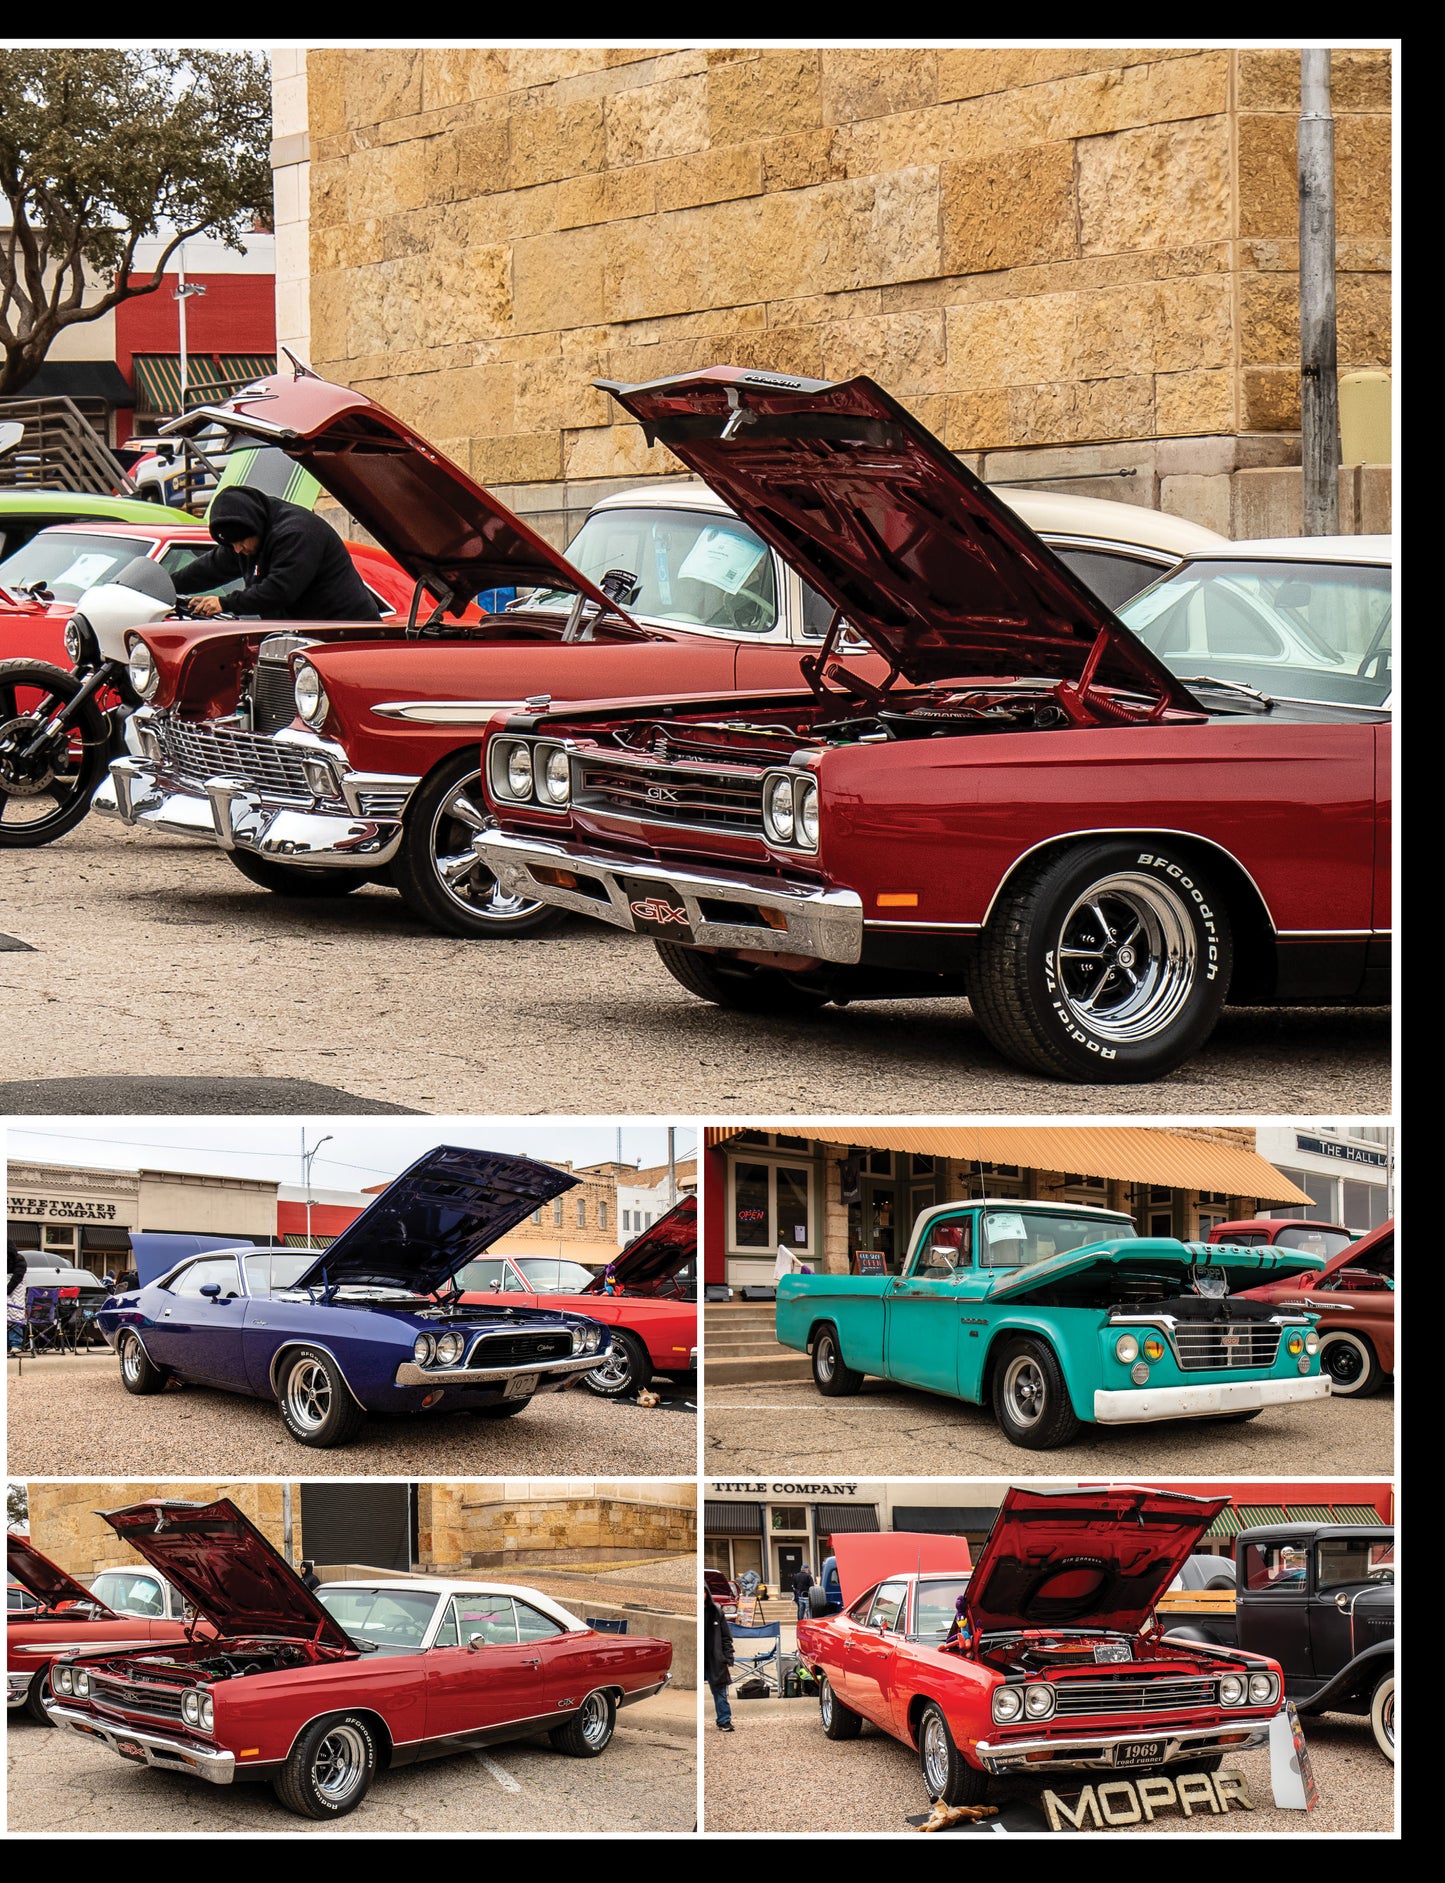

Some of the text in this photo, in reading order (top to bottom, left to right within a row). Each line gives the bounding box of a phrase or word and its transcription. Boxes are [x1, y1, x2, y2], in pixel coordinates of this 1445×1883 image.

[745, 375, 801, 388] PLYMOUTH
[647, 787, 678, 801] GTX
[631, 897, 690, 925] GTX
[1137, 853, 1218, 980] BFGoodrich
[1045, 950, 1117, 1060] Radial T/A
[1320, 1141, 1341, 1156] THE
[1346, 1147, 1374, 1164] HALL
[7, 1197, 116, 1212] WEETWATER
[49, 1208, 116, 1219] COMPANY
[738, 1209, 764, 1219] OPEN
[712, 1483, 858, 1494] TITLE COMPANY
[557, 1697, 576, 1707] GTX
[117, 1742, 146, 1757] GTX
[344, 1717, 373, 1768] BFGoodrich
[1124, 1744, 1158, 1758] 1969
[1116, 1756, 1163, 1766] road runner
[1042, 1770, 1256, 1832] MOPAR
